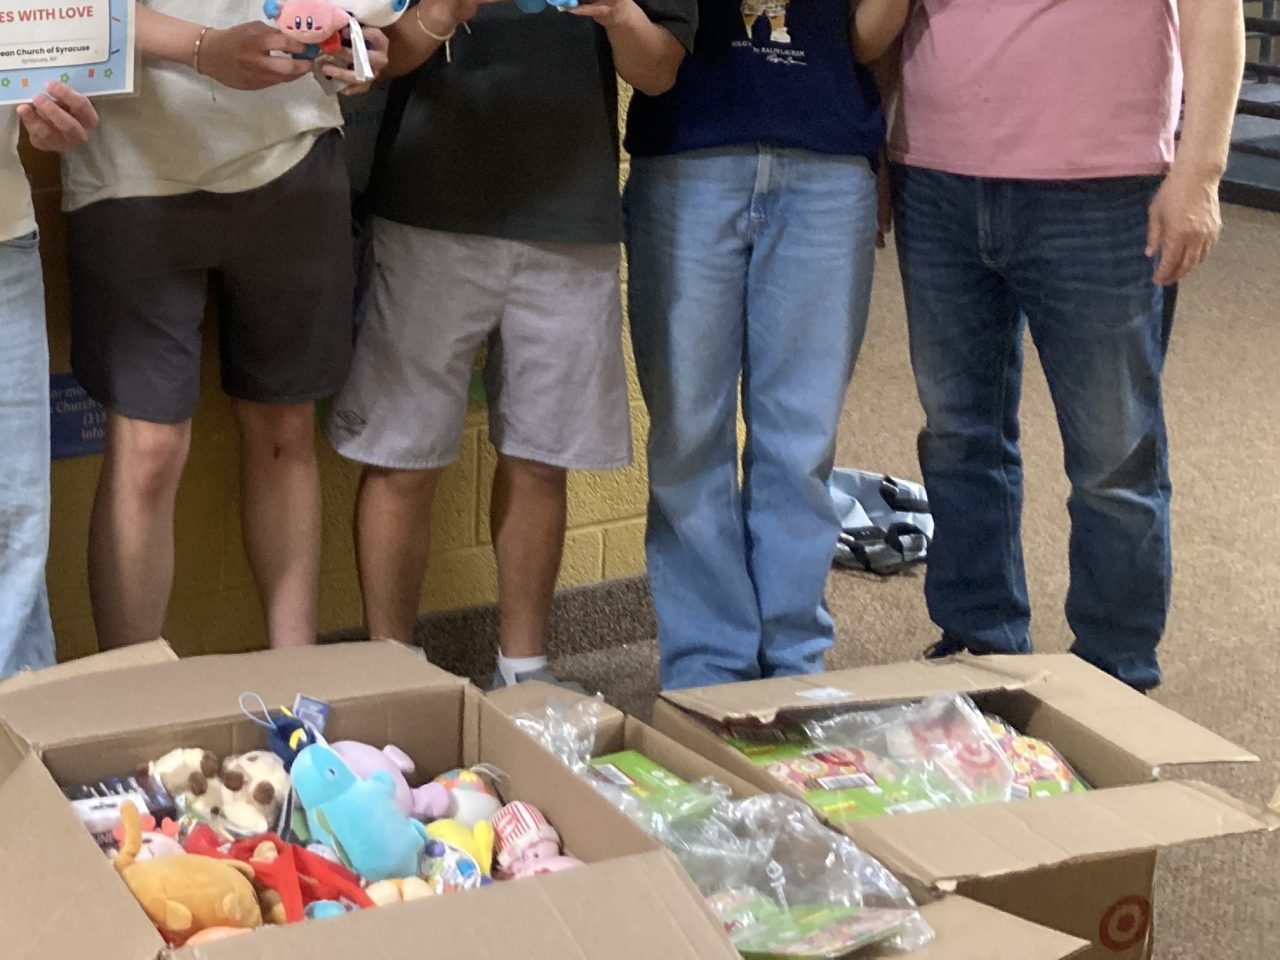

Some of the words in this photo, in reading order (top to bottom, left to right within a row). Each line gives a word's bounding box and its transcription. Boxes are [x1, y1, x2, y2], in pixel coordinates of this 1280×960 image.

[18, 8, 56, 22] WITH
[58, 6, 94, 20] LOVE
[16, 47, 45, 56] Church
[55, 45, 90, 54] Syracuse
